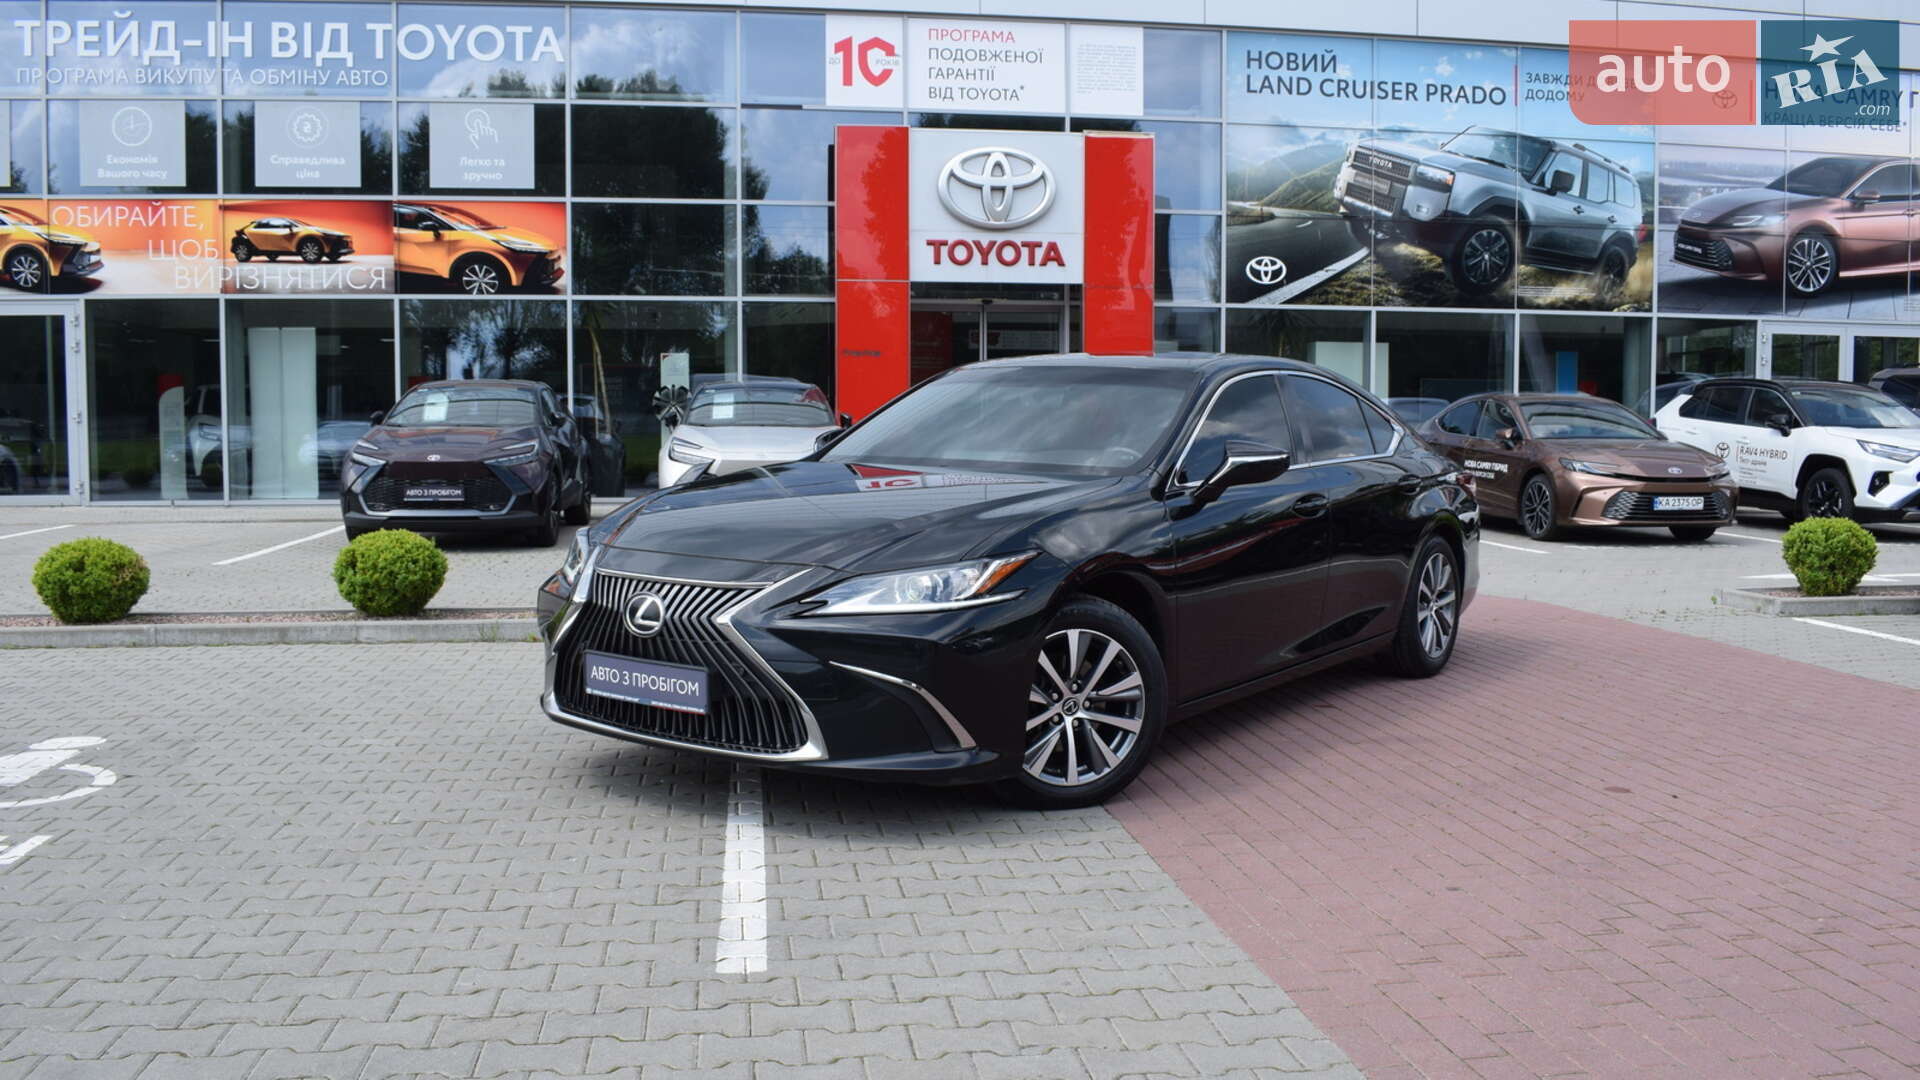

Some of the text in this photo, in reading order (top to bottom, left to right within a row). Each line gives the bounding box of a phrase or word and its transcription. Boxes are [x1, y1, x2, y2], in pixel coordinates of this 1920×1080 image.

[14, 10, 565, 68] ТРЕЙД-ІН ВІД TOYOTA
[928, 28, 1015, 44] ПРОГРАМА
[928, 47, 1044, 64] ПОДОВЖЕНОЇ
[1246, 49, 1338, 75] НОВИЙ
[16, 67, 388, 87] ПРОГРАМА ВИКУПУ ТА ОБМІНУ АВТО
[928, 66, 996, 82] ГАРАНТІЇ
[928, 86, 954, 102] ВІД
[1246, 75, 1507, 106] LAND CRUISER PRADO
[51, 201, 205, 230] ОБИРАЙТЕ,
[148, 239, 219, 264] ЩОБ
[926, 239, 1066, 267] TOYOTA
[175, 266, 387, 290] ВИРІЗНЯТИСЯ
[1740, 446, 1788, 461] RAV4 HYBRID
[590, 665, 620, 684] АВТО
[632, 672, 700, 697] ПРОБІГОМ
